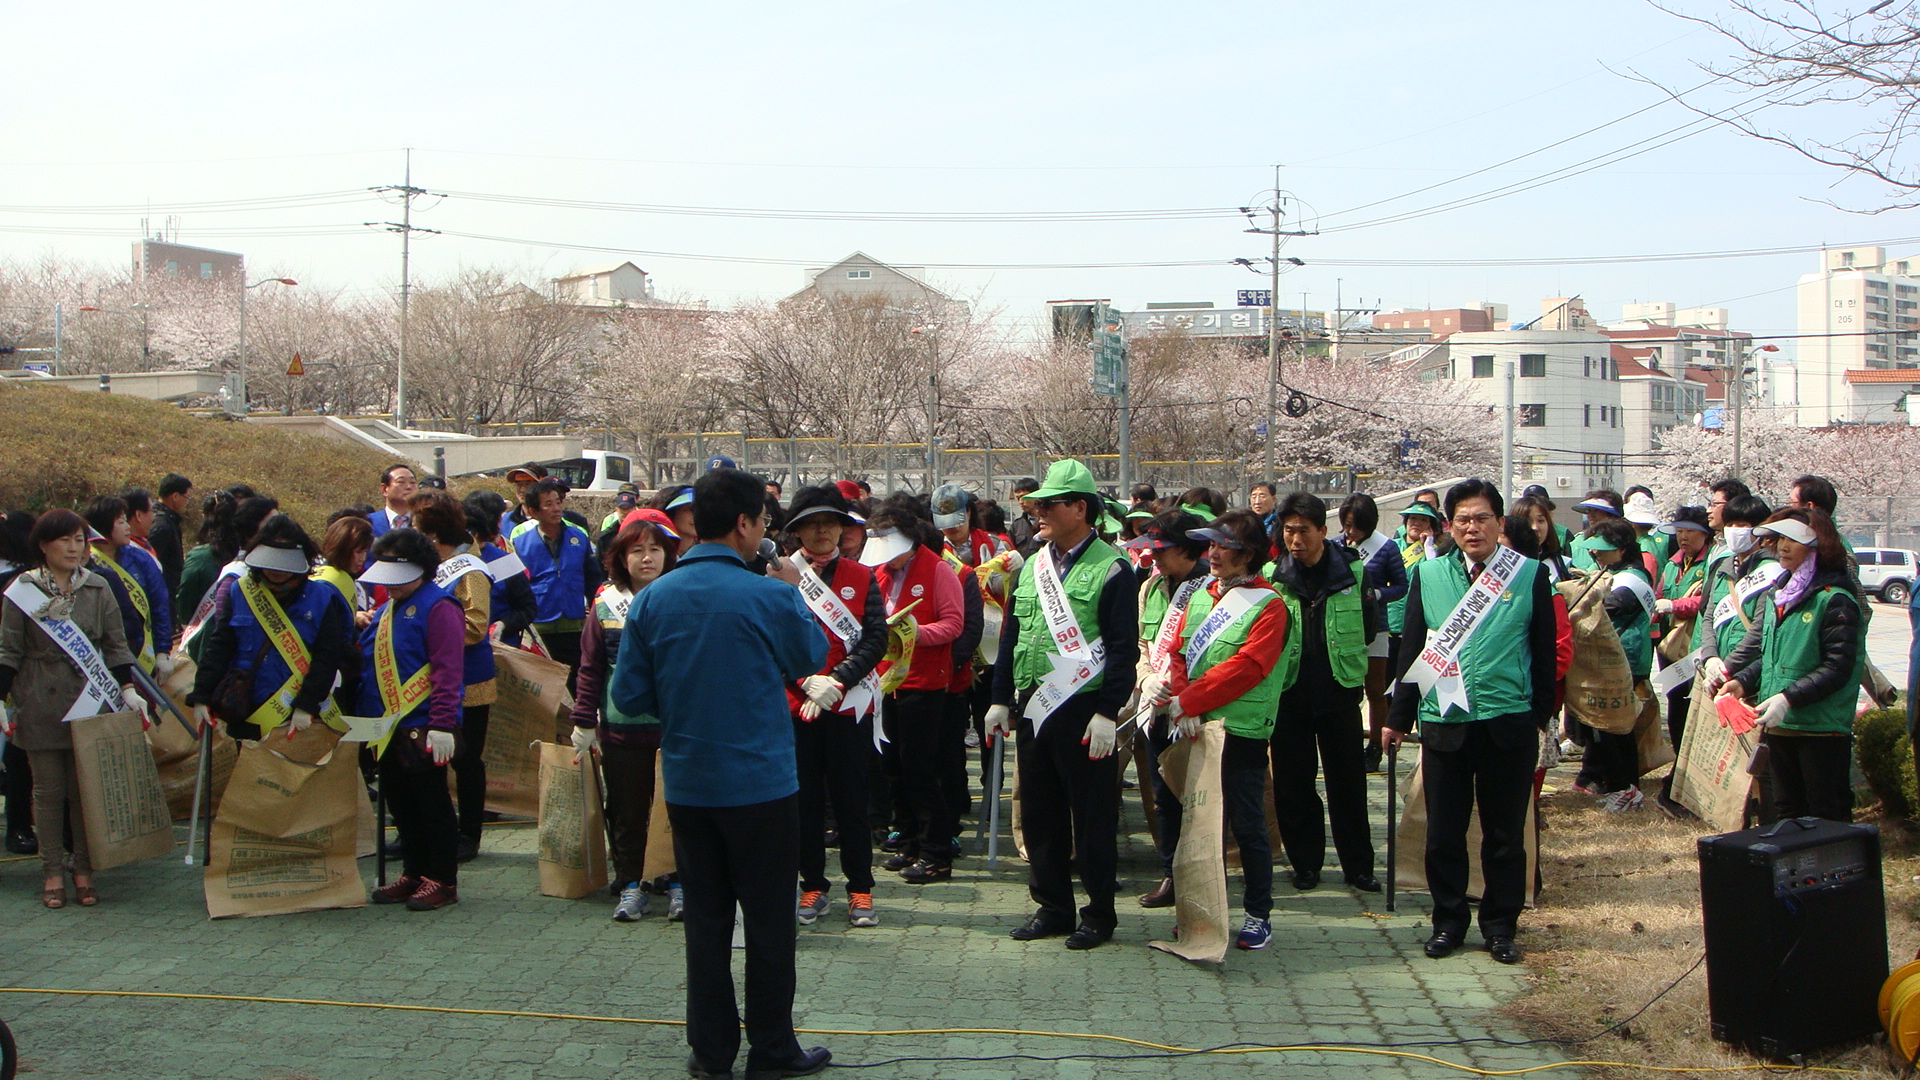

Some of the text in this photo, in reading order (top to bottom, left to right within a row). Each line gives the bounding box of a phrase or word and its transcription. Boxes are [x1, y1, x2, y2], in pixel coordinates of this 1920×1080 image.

[1837, 315, 1853, 323] 205
[1480, 572, 1504, 595] 5초
[1421, 648, 1448, 673] 50년
